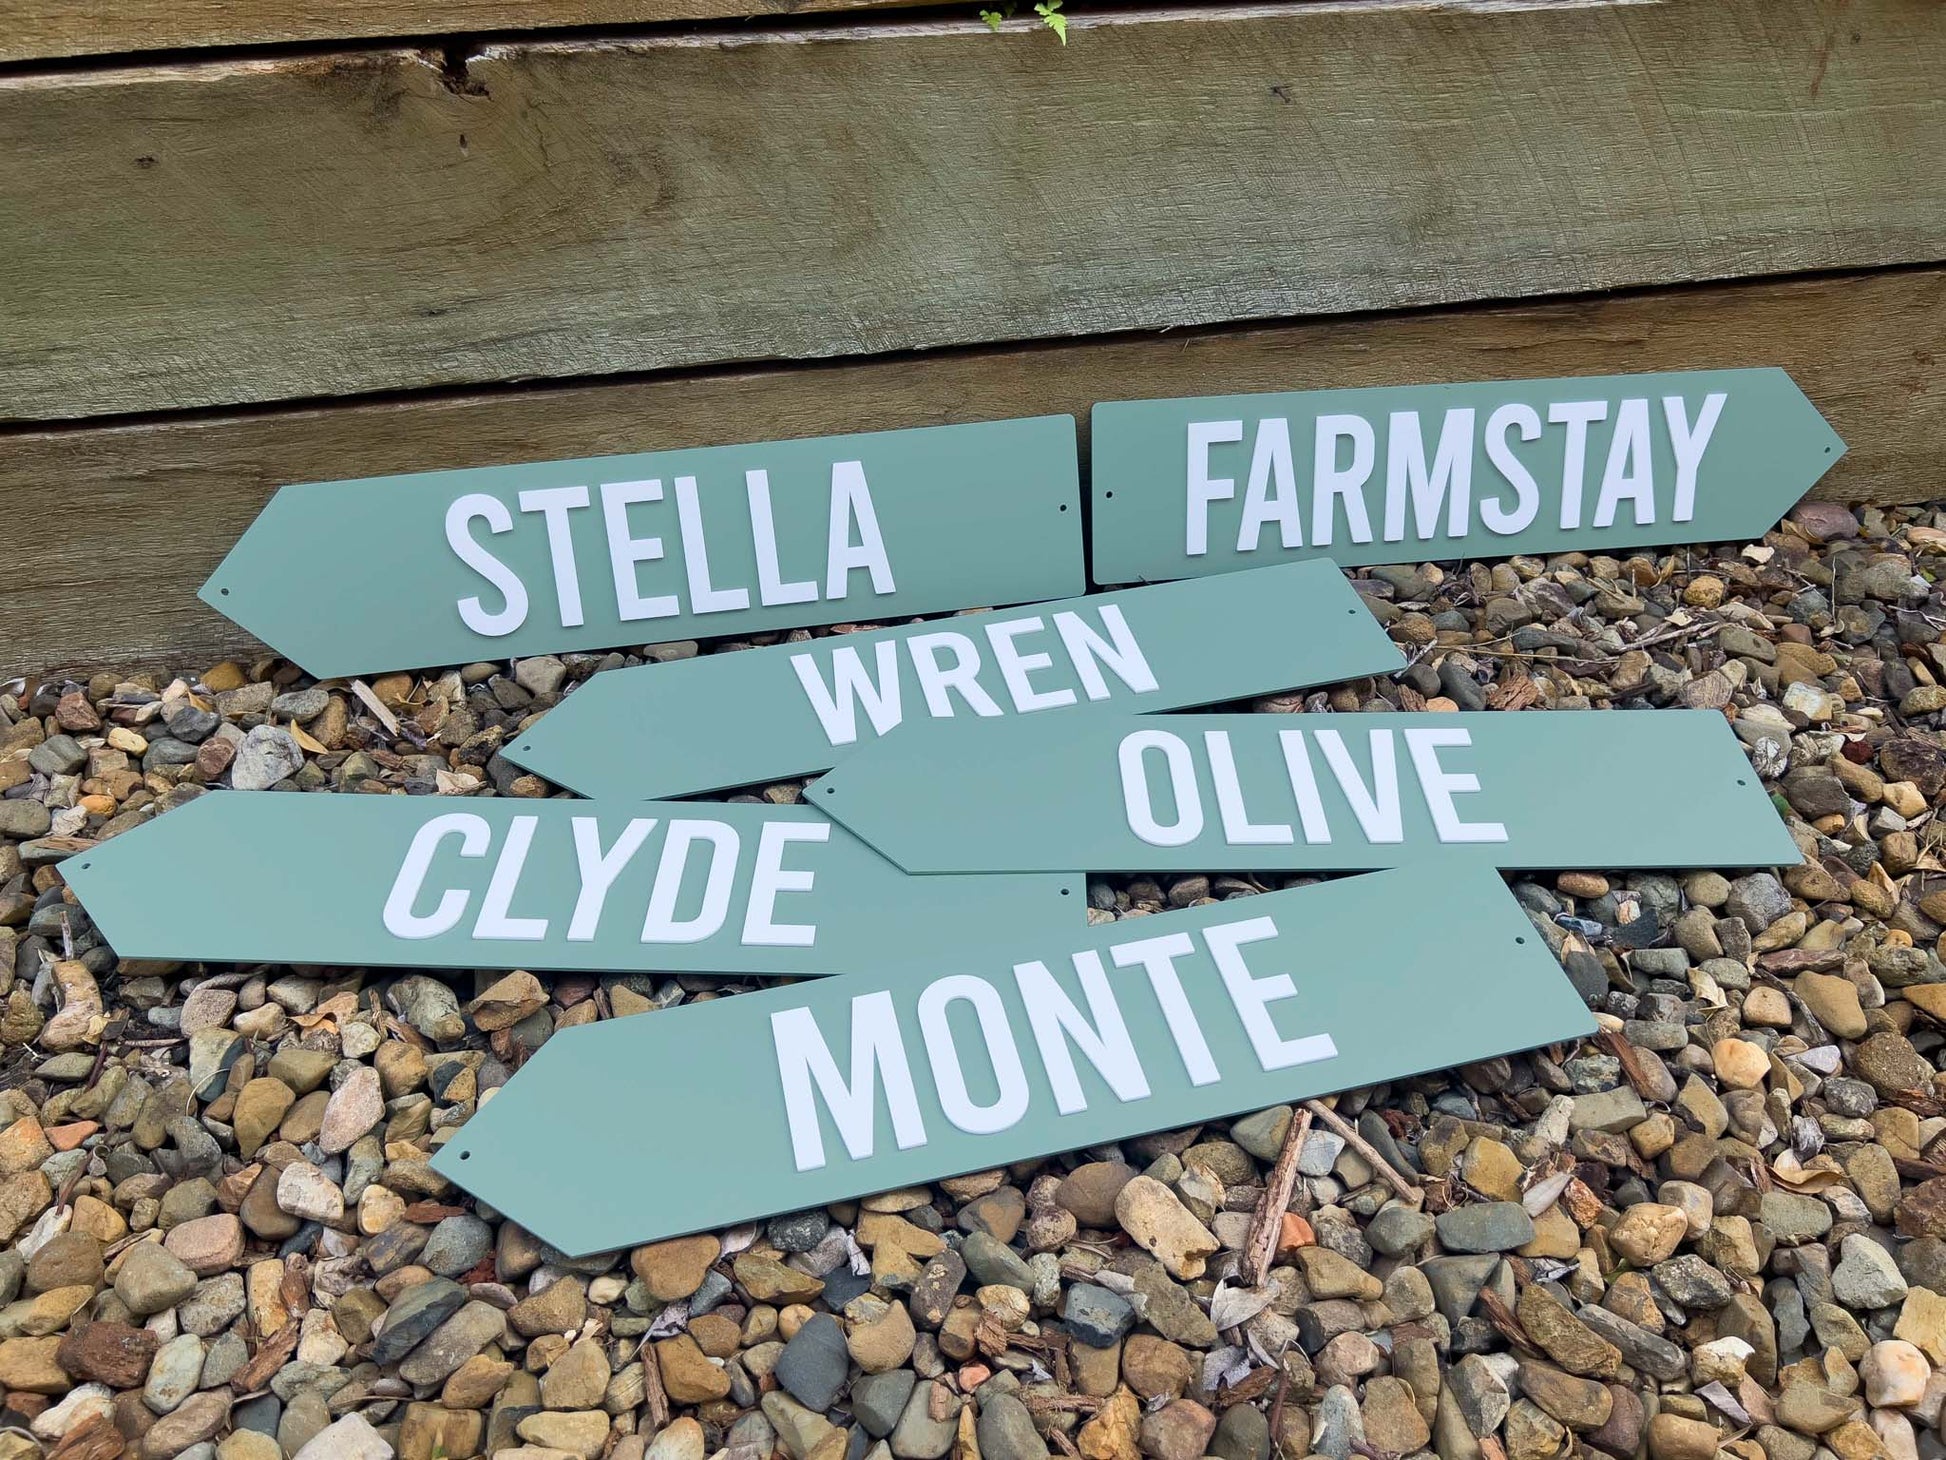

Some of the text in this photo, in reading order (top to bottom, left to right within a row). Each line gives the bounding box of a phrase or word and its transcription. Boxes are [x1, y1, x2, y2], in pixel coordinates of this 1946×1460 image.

[446, 460, 895, 637] STELLA
[1186, 393, 1727, 556] FARMSTAY
[790, 604, 1160, 746] WREN
[1119, 727, 1508, 847] OLIVE
[383, 813, 831, 946] CLYDE
[770, 915, 1339, 1171] MONTE
